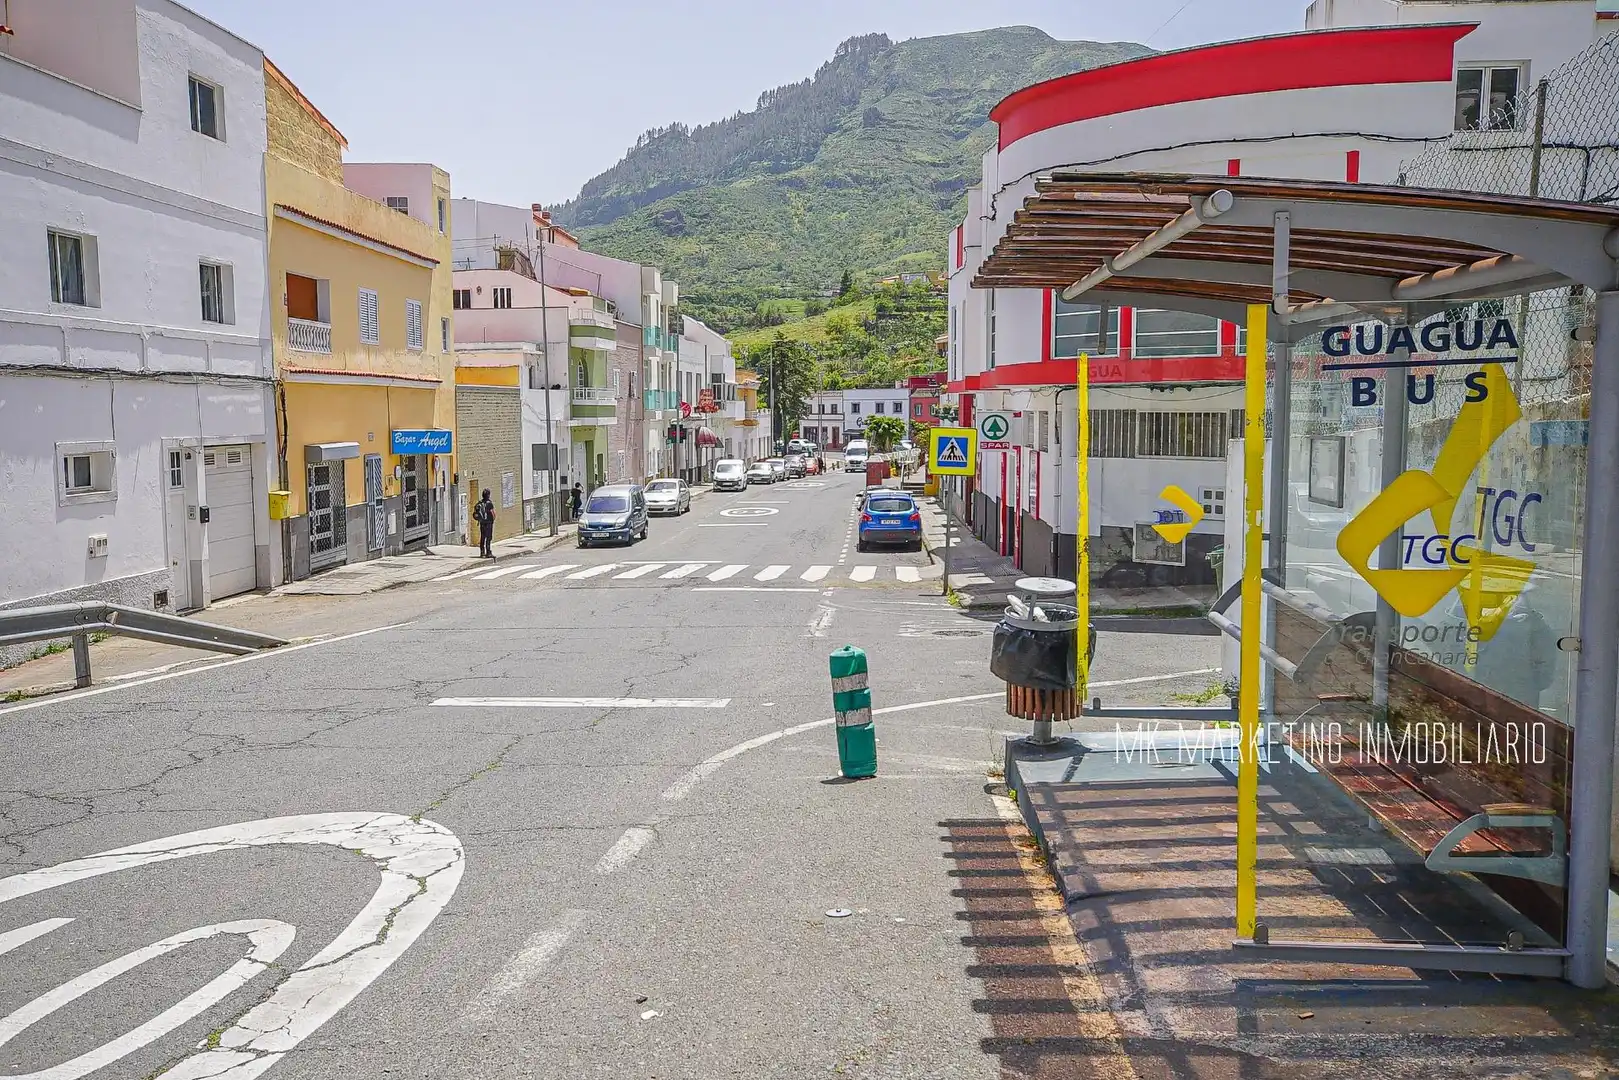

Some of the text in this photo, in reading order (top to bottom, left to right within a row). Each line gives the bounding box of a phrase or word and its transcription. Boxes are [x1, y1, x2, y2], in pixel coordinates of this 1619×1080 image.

[1321, 320, 1519, 357] GUAGUA
[394, 431, 449, 451] Bazar Angel
[1401, 535, 1476, 565] TGC
